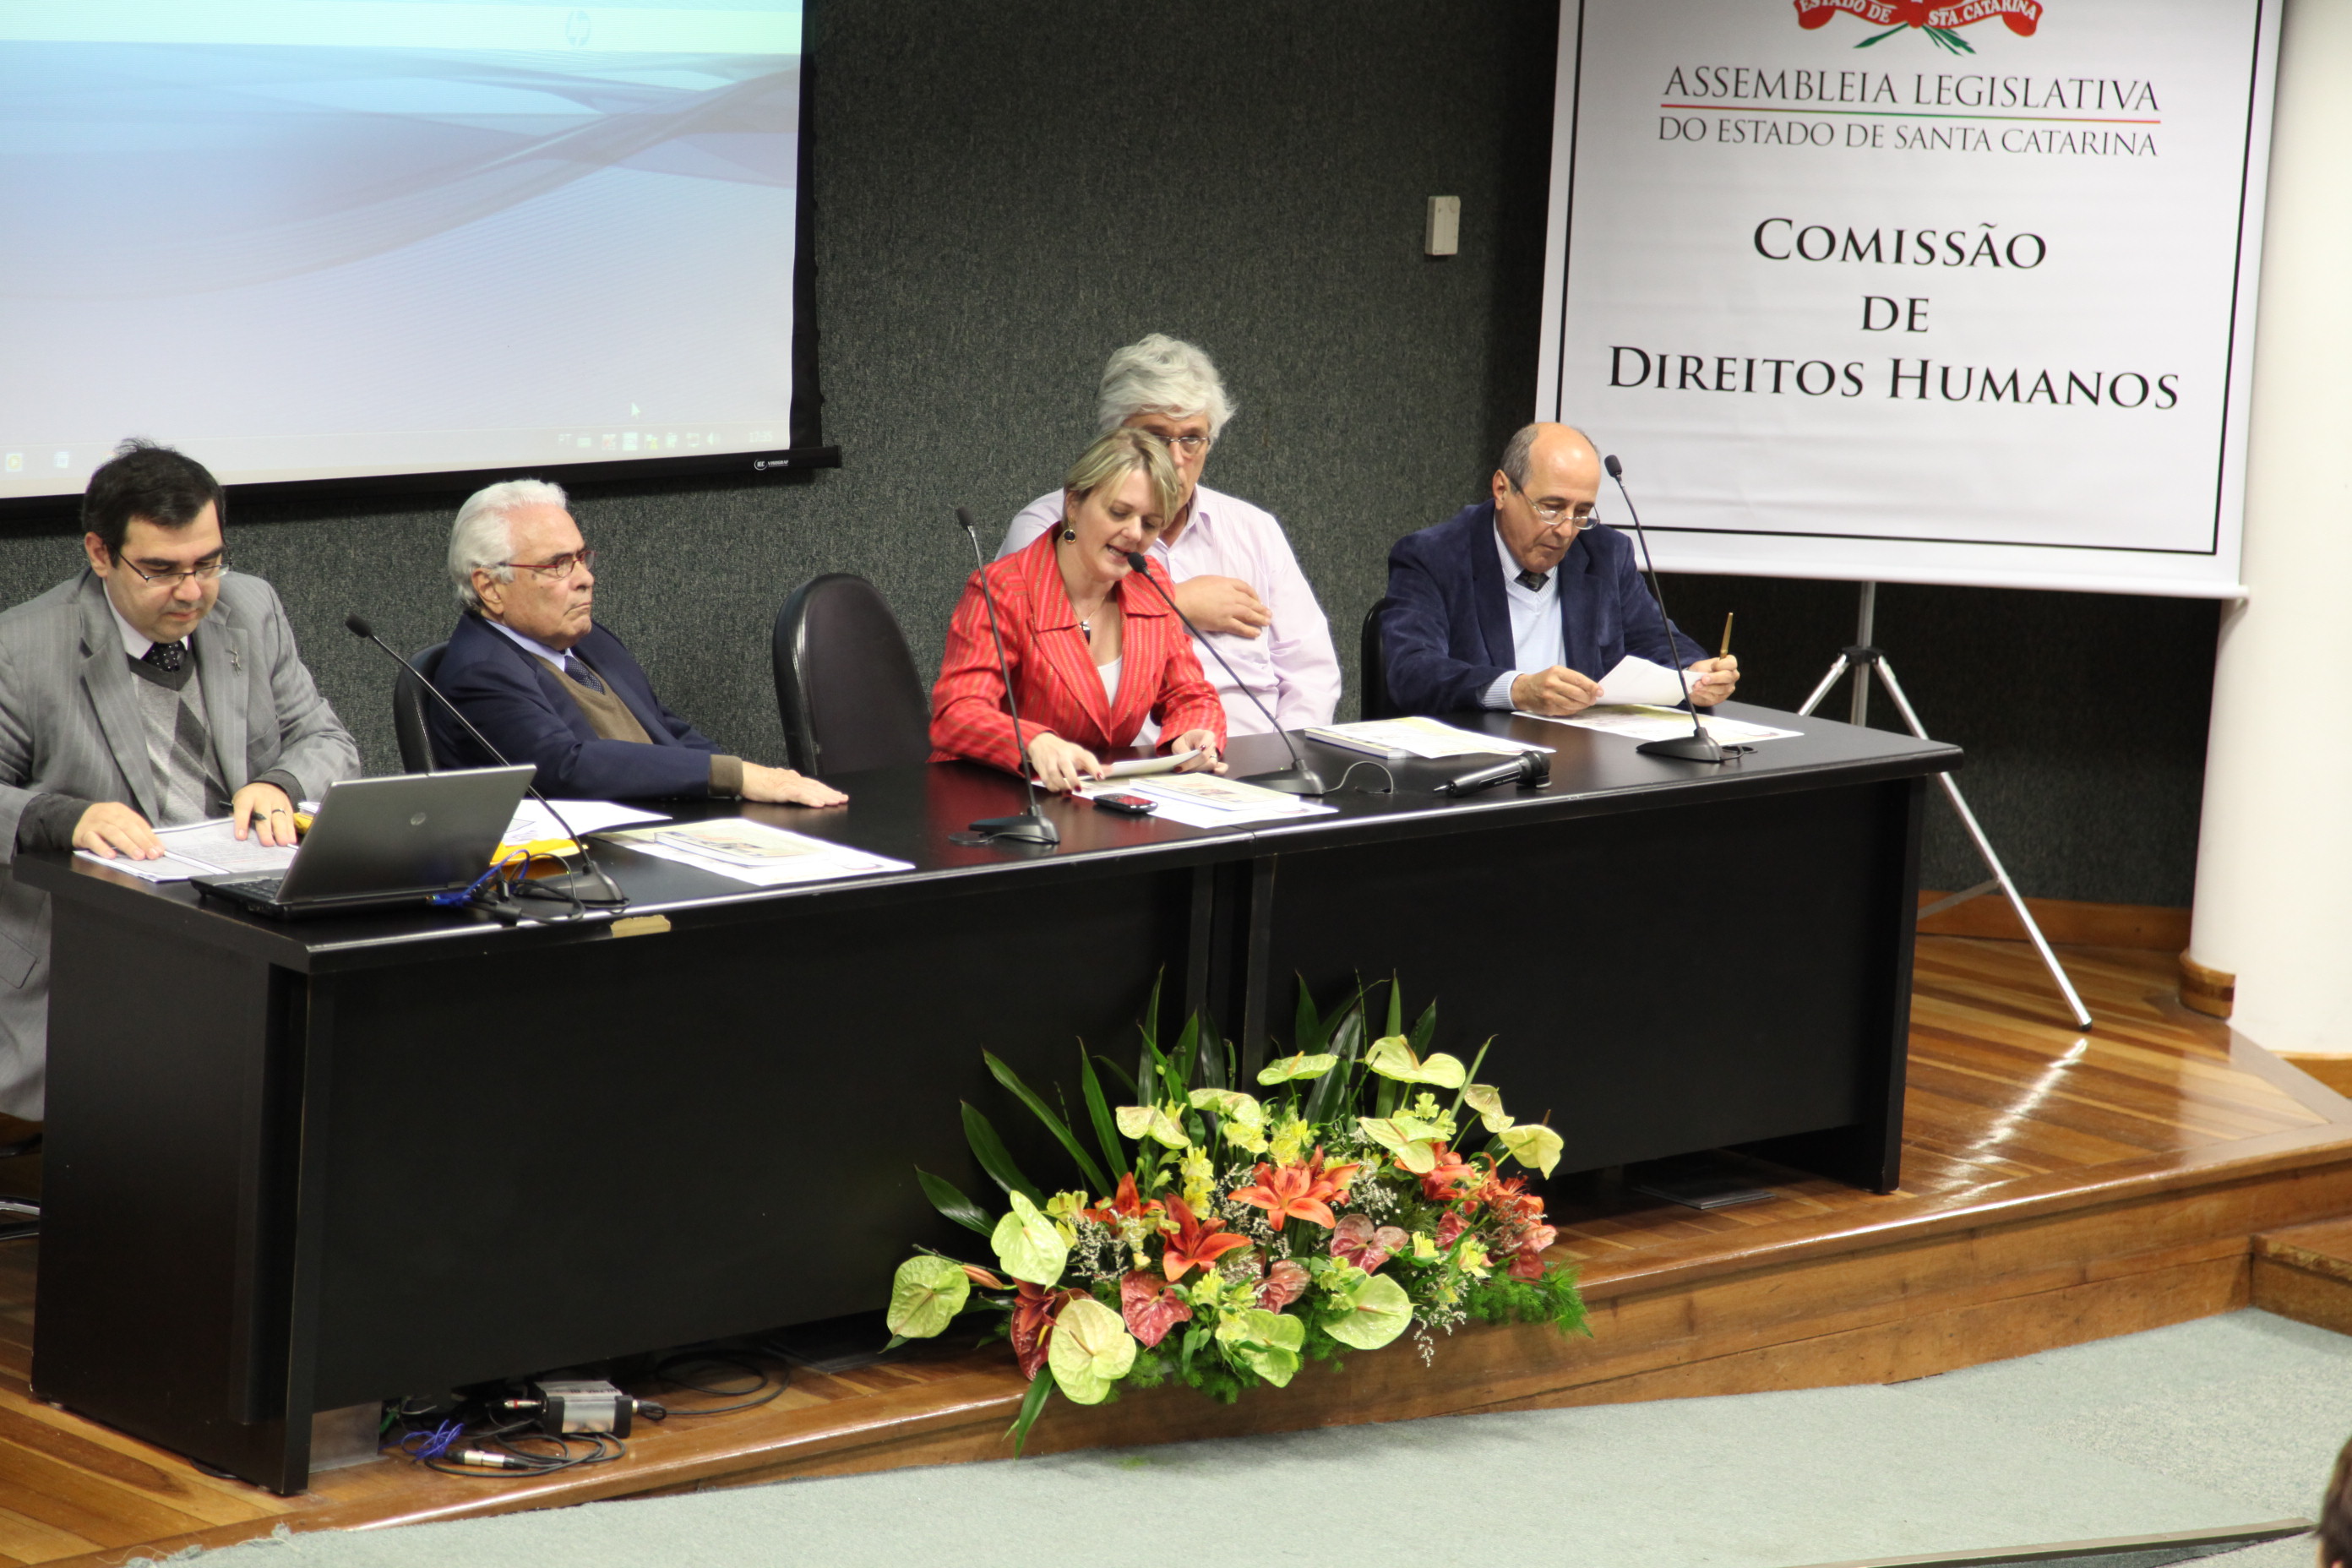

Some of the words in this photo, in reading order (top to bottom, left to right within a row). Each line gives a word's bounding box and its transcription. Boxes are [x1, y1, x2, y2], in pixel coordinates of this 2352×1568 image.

[1866, 3, 1892, 24] DE
[1663, 65, 1897, 104] ASSEMBLEIA
[1914, 74, 2160, 112] LEGISLATIVA
[1658, 116, 1707, 142] DO
[1718, 118, 1835, 146] ESTADO
[1845, 123, 1884, 149] DE
[1895, 126, 1993, 152] SANTA
[2000, 129, 2159, 156] CATARINA
[1753, 217, 2048, 270] COMISSÃO
[1860, 295, 1931, 333] DE
[1608, 345, 1865, 398] DIREITOS
[1888, 357, 2180, 411] HUMANOS
